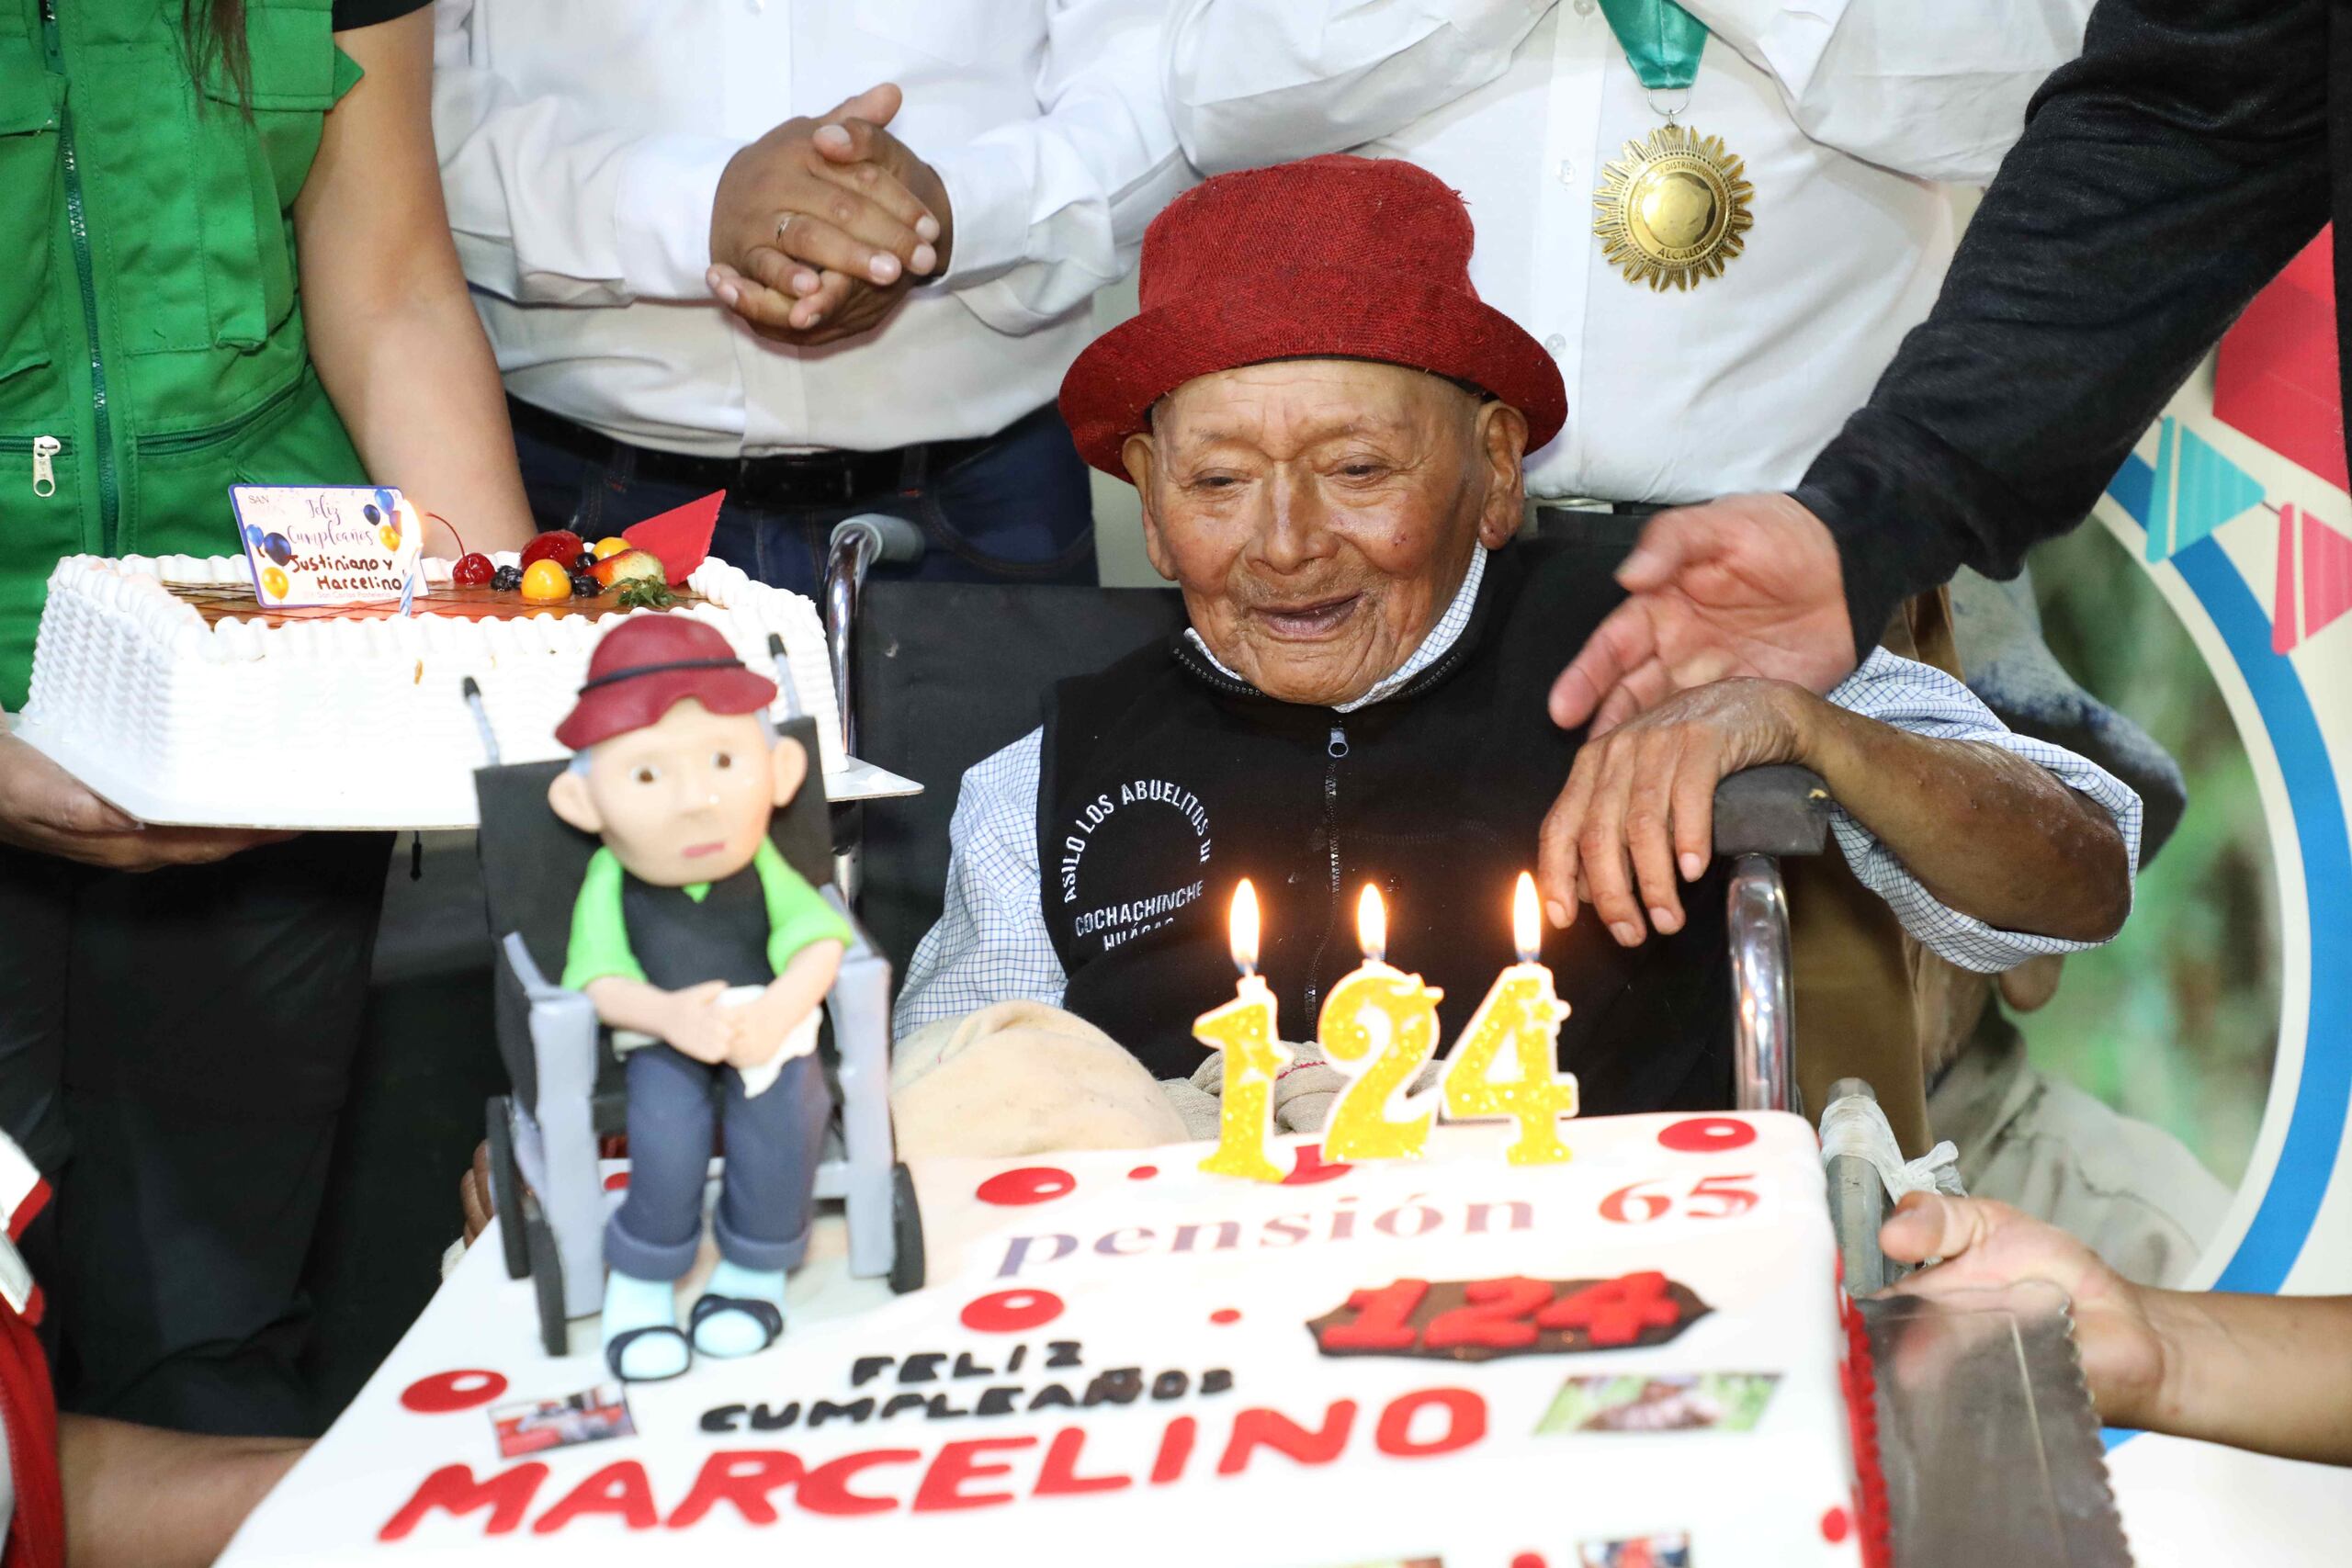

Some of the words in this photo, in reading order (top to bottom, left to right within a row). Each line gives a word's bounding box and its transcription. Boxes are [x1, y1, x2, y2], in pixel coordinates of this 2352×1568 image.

[1657, 240, 1709, 260] ALCALDE
[305, 494, 341, 525] Feliz
[287, 554, 379, 573] Justiniano
[1061, 836, 1086, 904] ASILO
[1076, 794, 1114, 834] LOS
[1121, 779, 1209, 836] ABUELITOS
[1074, 880, 1204, 937] COCHACHINCHE
[1192, 960, 1580, 1185] 124
[995, 1193, 1535, 1280] pensión
[1597, 1173, 1760, 1225] 65
[1319, 1270, 1683, 1348] 124
[851, 1340, 1083, 1388] FELIZ
[375, 1386, 1489, 1544] MARCELINO
